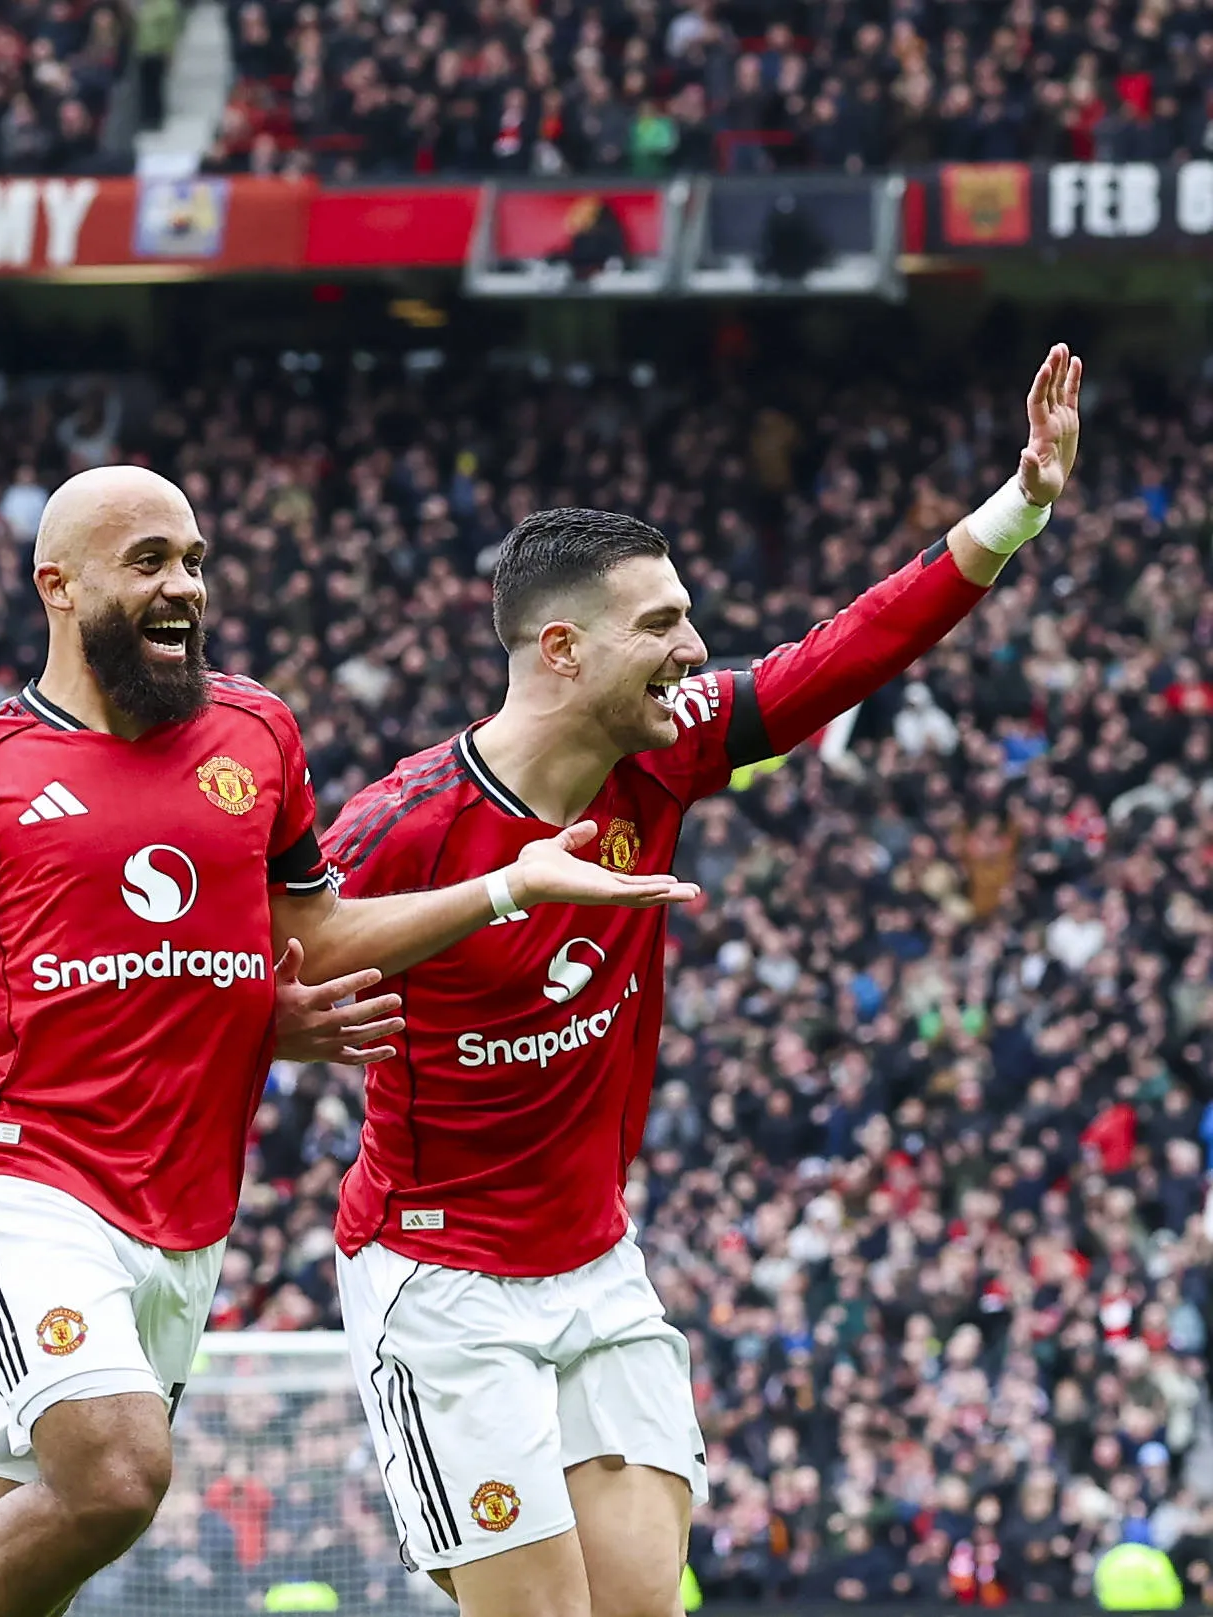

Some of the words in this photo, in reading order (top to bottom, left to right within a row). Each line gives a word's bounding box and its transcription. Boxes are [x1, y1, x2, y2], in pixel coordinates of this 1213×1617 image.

[1049, 162, 1161, 238] FEB
[218, 799, 249, 811] UNITED
[32, 940, 266, 991] Snapdragon
